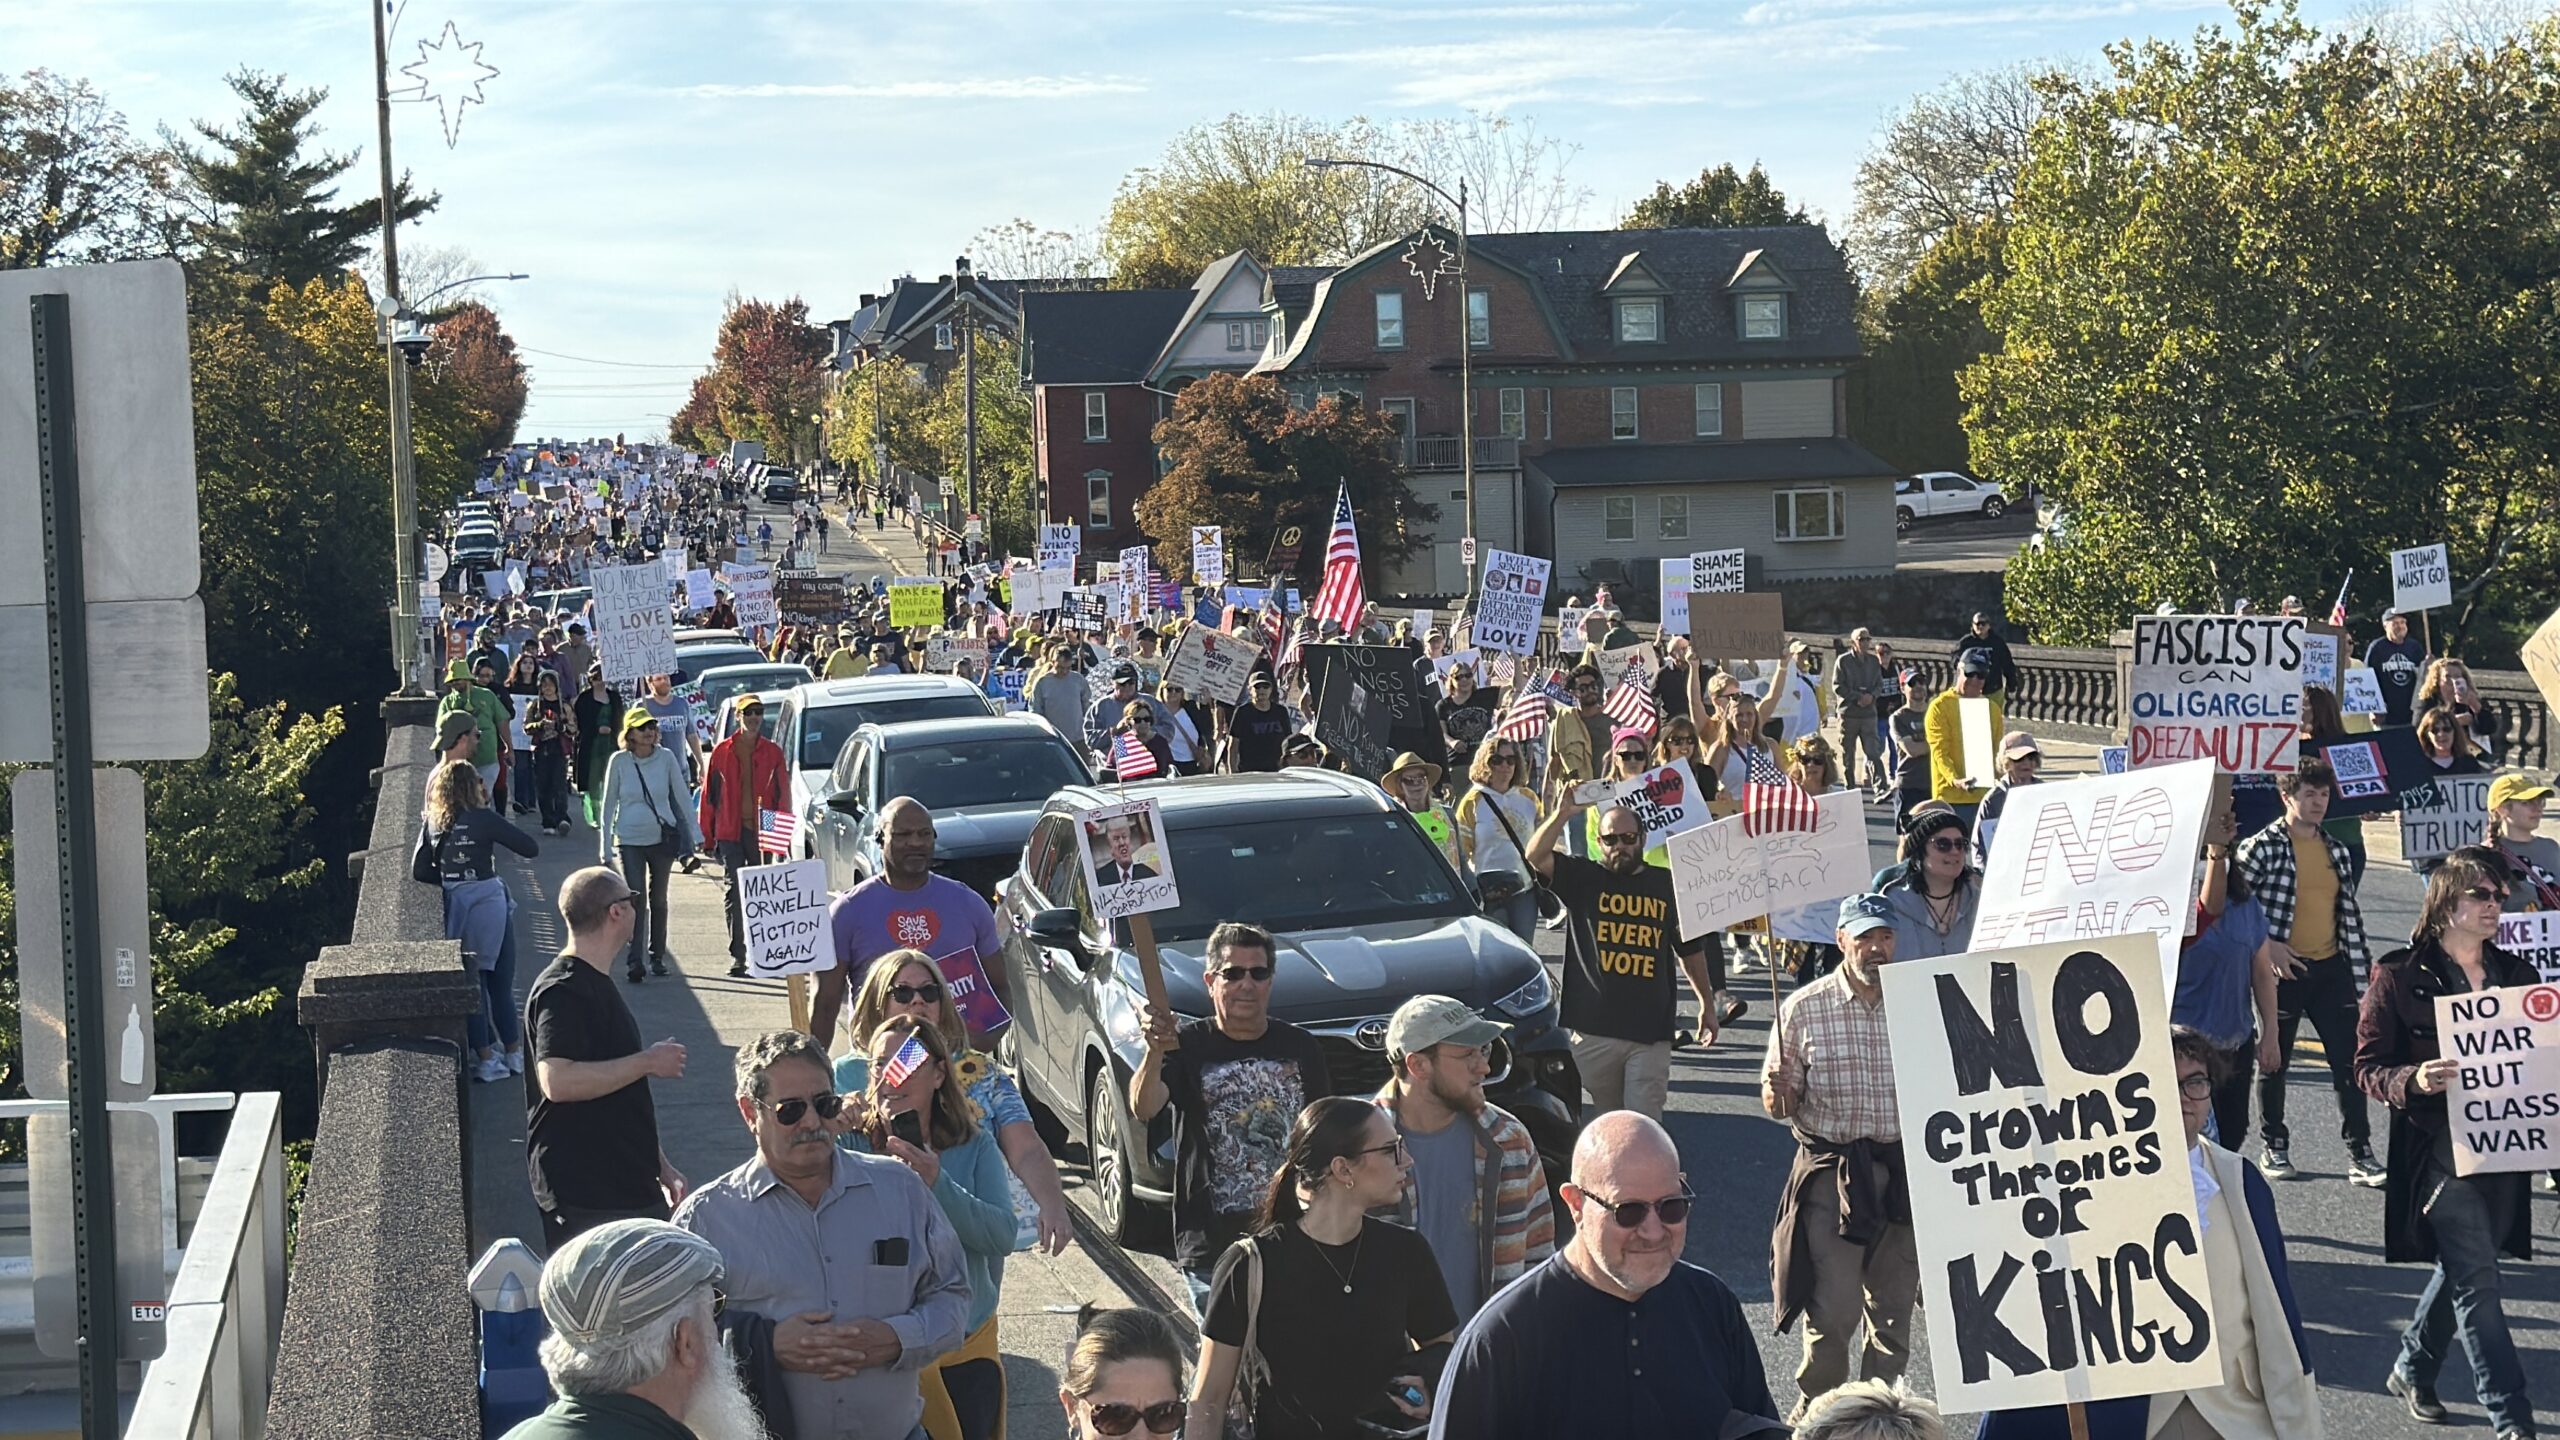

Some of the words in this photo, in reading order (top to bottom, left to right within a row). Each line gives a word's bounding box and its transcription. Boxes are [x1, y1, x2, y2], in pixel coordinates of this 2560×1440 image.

[1052, 528, 1071, 540] NO
[1044, 542, 1080, 555] KINGS
[1497, 562, 1523, 572] SEND
[1504, 555, 1531, 566] WILL
[1693, 553, 1743, 571] SHAME
[2402, 549, 2438, 570] TRUMP
[593, 571, 615, 593] NO
[803, 583, 816, 593] my
[1693, 570, 1743, 589] SHAME
[2397, 571, 2425, 590] MUST
[2428, 566, 2446, 583] GO!
[894, 587, 928, 597] MAKE
[747, 602, 761, 611] NO
[1480, 606, 1492, 616] TO
[1493, 608, 1533, 622] REMIND
[1481, 599, 1533, 613] BATTALION
[1563, 612, 1576, 620] NO
[620, 609, 666, 630] LOVE
[740, 611, 770, 624] KINGS!
[783, 611, 798, 622] NO
[1061, 617, 1074, 628] NO
[1075, 620, 1102, 631] KINGS
[1479, 614, 1498, 625] YOU
[1499, 618, 1513, 628] OF
[601, 628, 671, 655] AMERICA
[942, 640, 985, 652] PATRIOTS
[1481, 627, 1527, 648] LOVE
[2134, 618, 2304, 671] FASCISTS
[1204, 649, 1233, 666] HANDS
[1342, 646, 1376, 671] NO
[2382, 661, 2398, 672] PENN
[2178, 670, 2251, 684] CAN
[2132, 690, 2299, 718] OLIGARGLE
[1338, 704, 1359, 742] NO
[1616, 777, 1683, 808] UNTRUMP
[2342, 782, 2385, 796] PSA
[1635, 803, 1666, 819] THE
[1766, 837, 1799, 852] OFF
[2021, 787, 2173, 896] NO
[745, 869, 799, 899] MAKE
[1738, 869, 1768, 886] OUR
[1110, 876, 1177, 916] CORRUPTION
[1697, 862, 1831, 920] DEMOCRACY
[745, 889, 826, 919] ORWELL
[1599, 891, 1667, 921] COUNT
[749, 914, 821, 948] FICTION
[898, 915, 928, 928] SAVE
[898, 929, 932, 945] CFPB
[1597, 921, 1663, 949] EVERY
[766, 936, 816, 962] AGAIN
[1600, 950, 1656, 978] VOTE
[2452, 996, 2500, 1023] NO
[1934, 950, 2142, 1096] NO
[2453, 1026, 2535, 1057] WAR
[2461, 1061, 2524, 1090] BUT
[2464, 1093, 2560, 1123] CLASS
[2467, 1127, 2548, 1154] WAR
[135, 1307, 161, 1318] ETC
